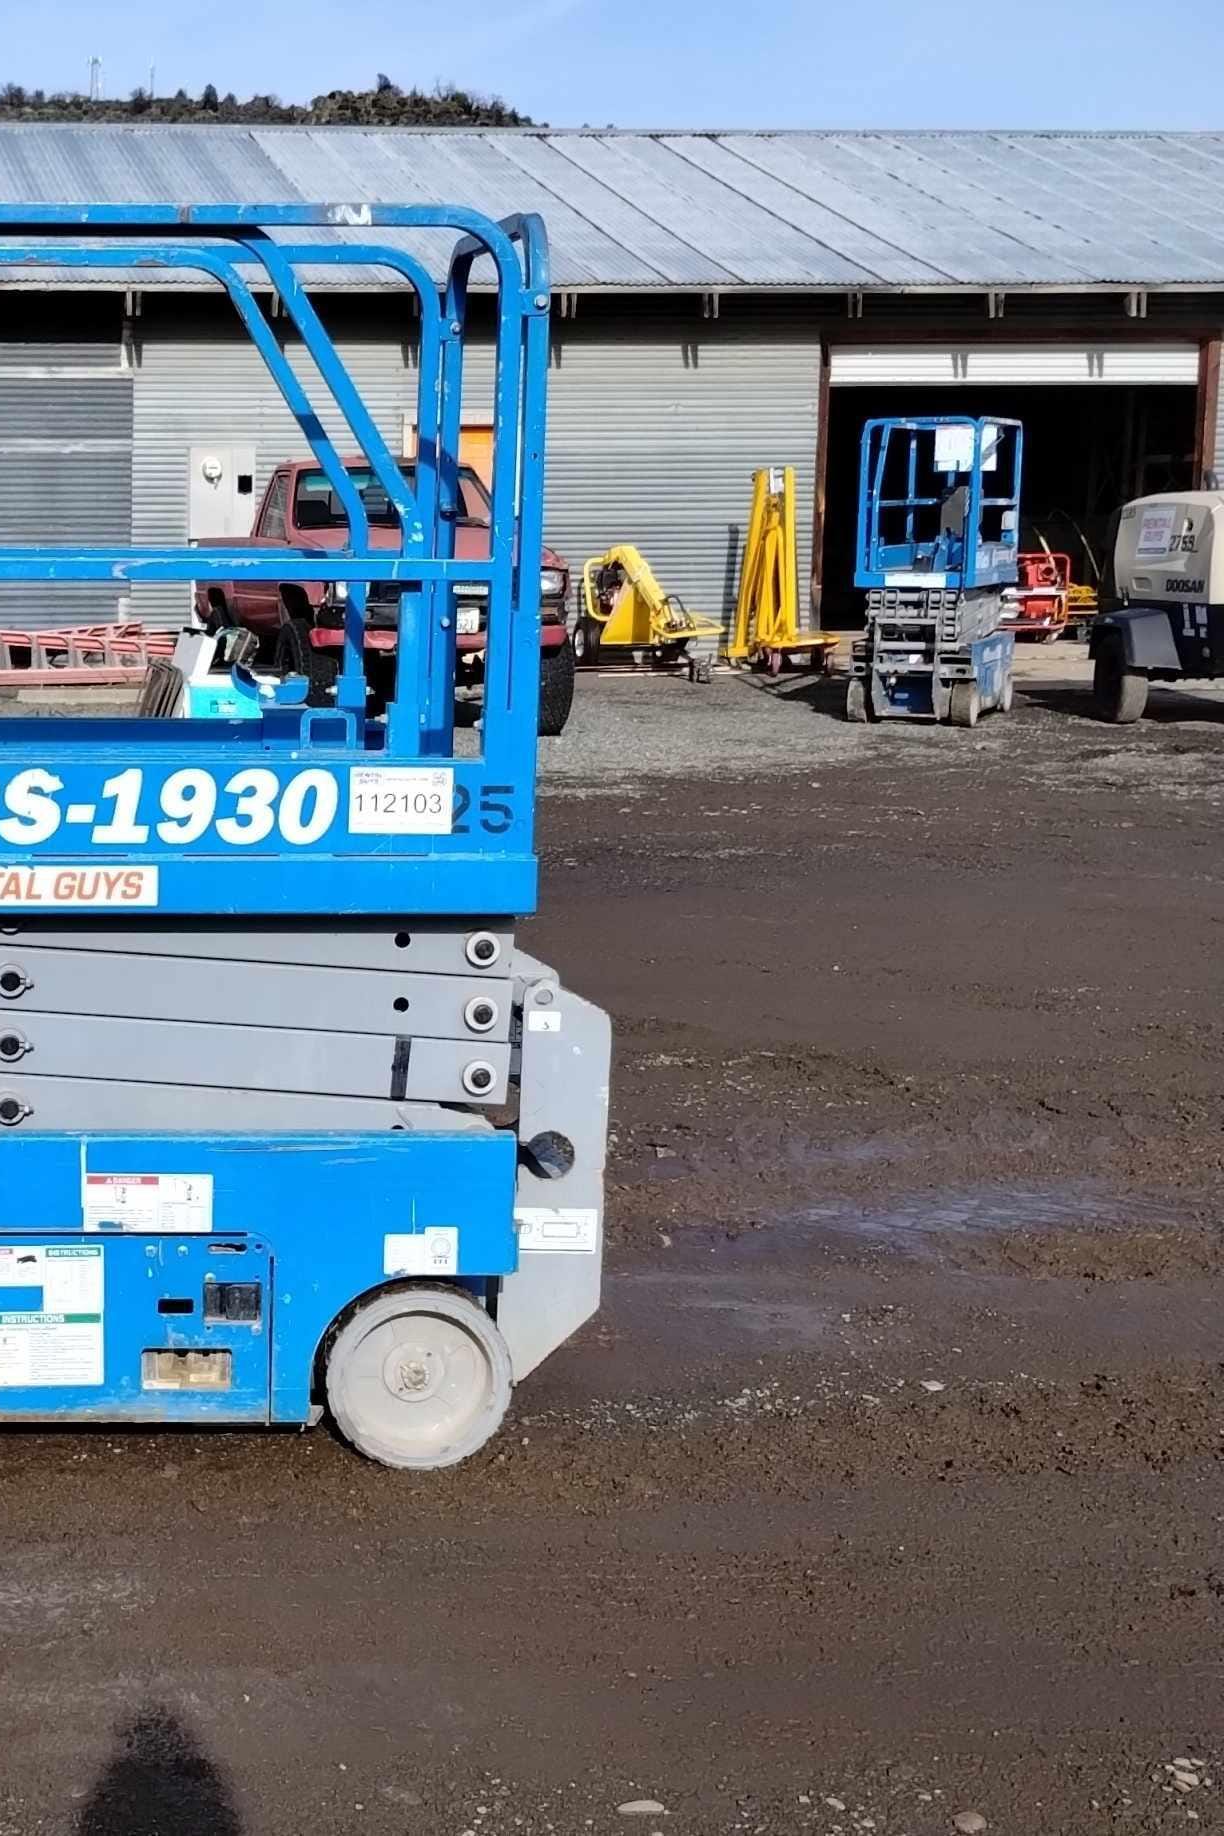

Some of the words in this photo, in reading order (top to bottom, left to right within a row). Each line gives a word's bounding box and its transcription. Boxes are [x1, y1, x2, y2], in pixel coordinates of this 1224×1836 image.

[1165, 579, 1205, 593] DOOSAN
[354, 793, 442, 814] 112103
[53, 871, 144, 900] GUYS
[1, 1314, 65, 1324] INSTRUCTIONS
